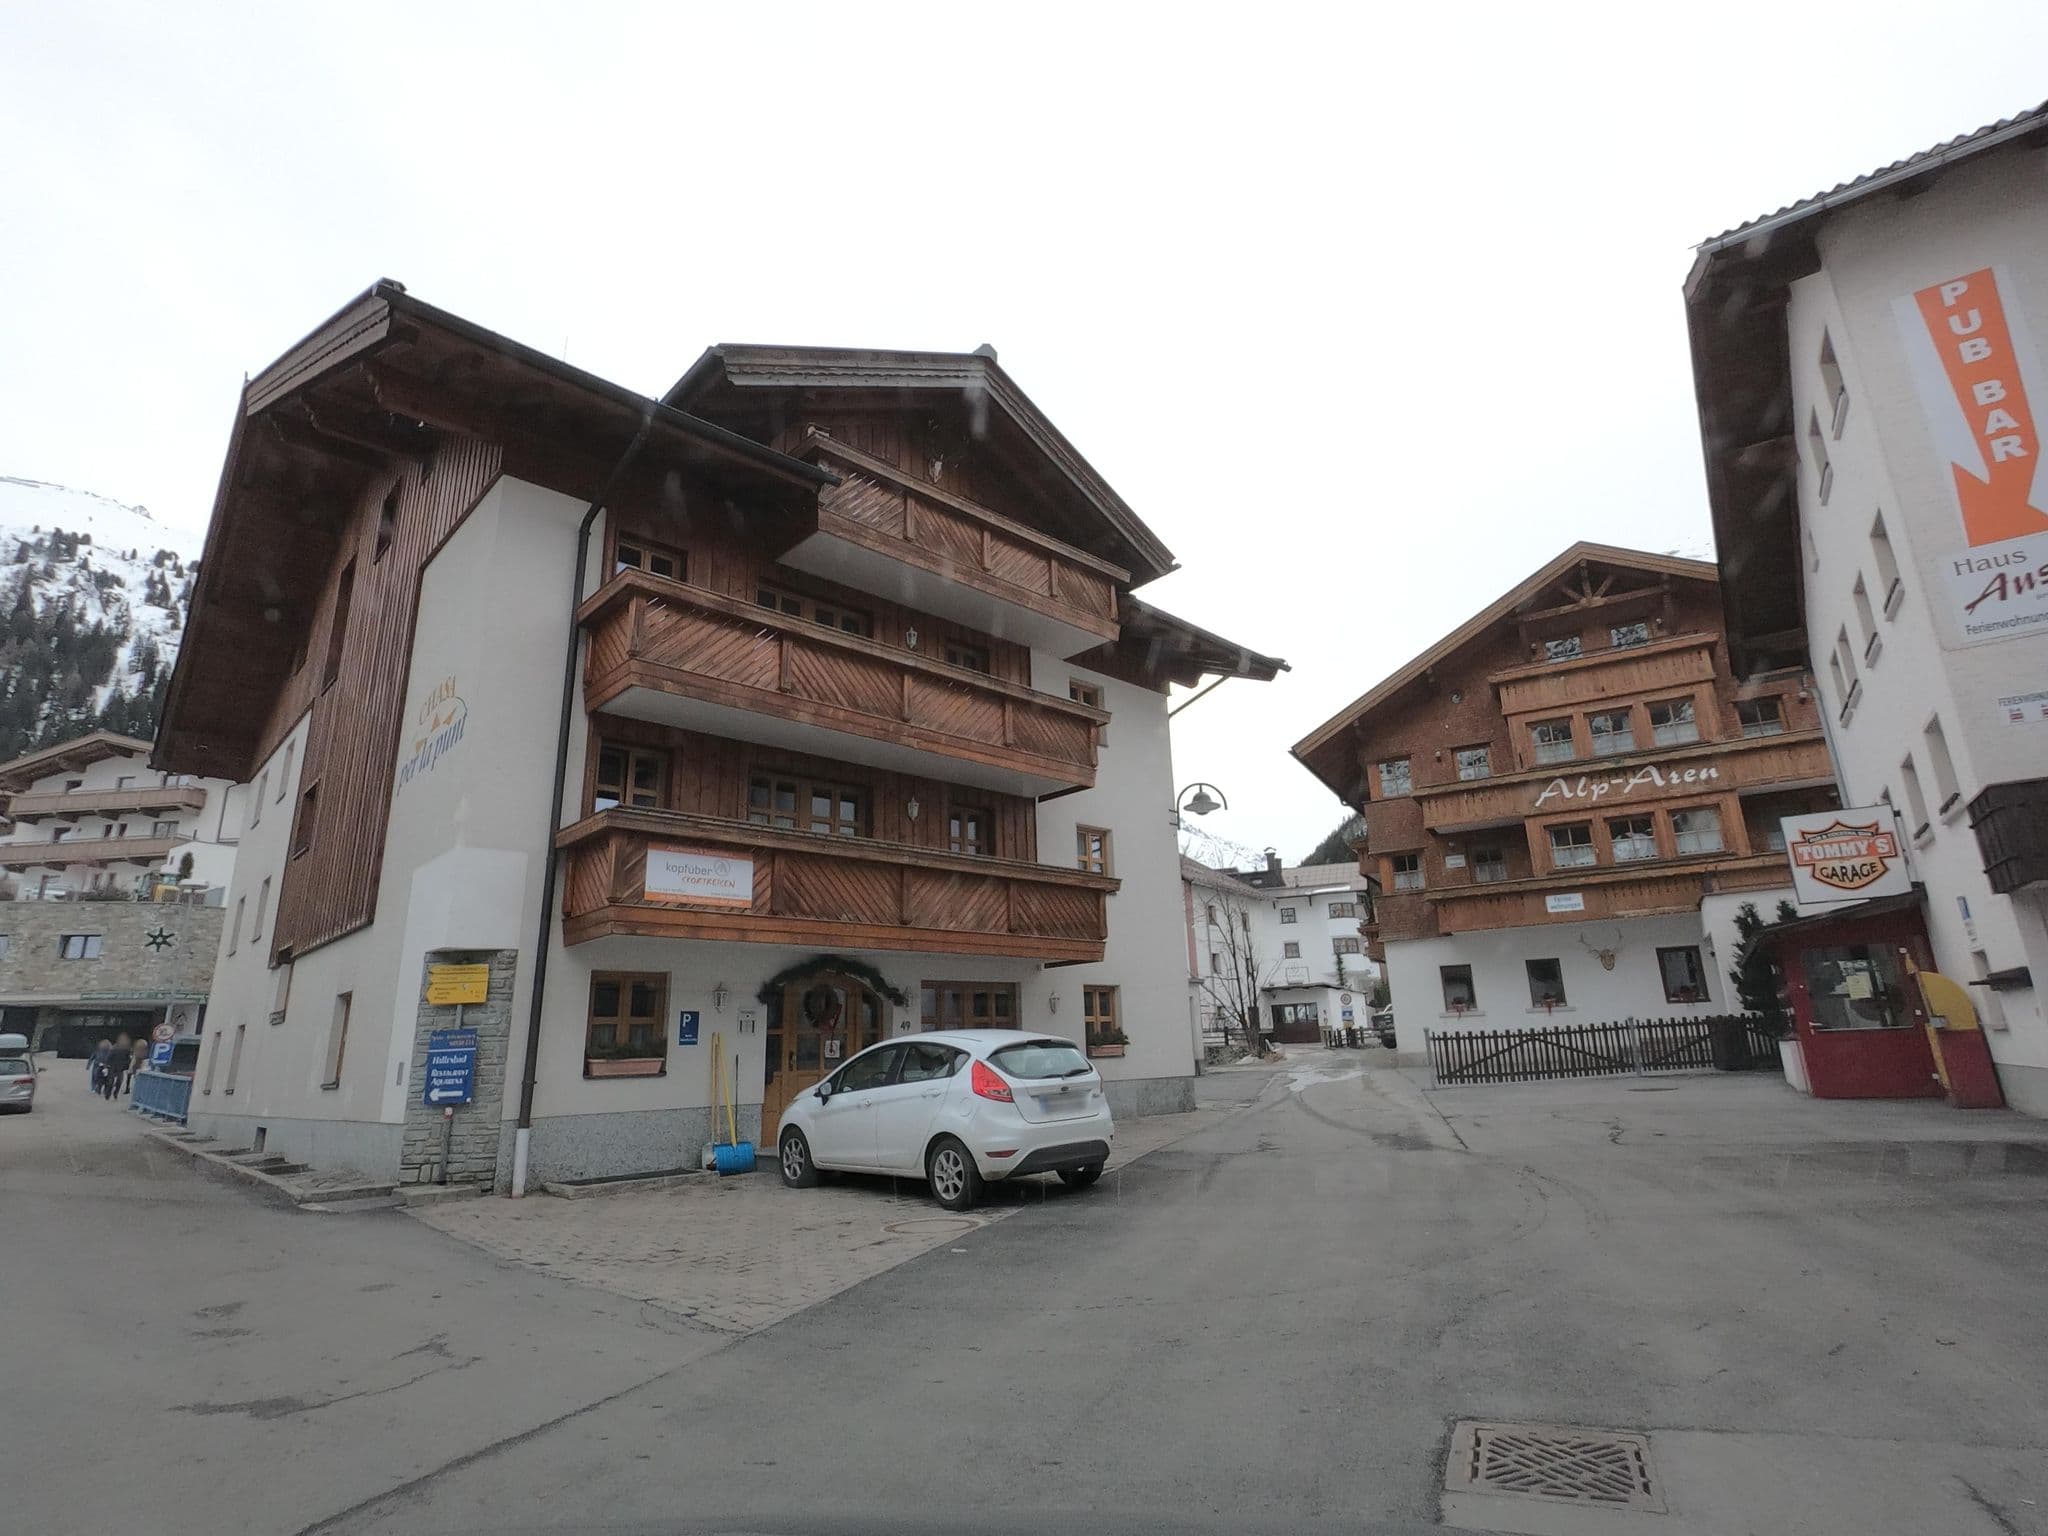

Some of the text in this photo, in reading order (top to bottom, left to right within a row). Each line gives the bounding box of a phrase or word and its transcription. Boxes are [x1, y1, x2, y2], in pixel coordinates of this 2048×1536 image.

[1939, 281, 2029, 463] PUB BAR
[1953, 550, 2028, 576] Haus
[1820, 862, 1879, 882] GARAGE
[683, 1013, 691, 1027] P
[900, 1020, 911, 1031] 49
[154, 1043, 170, 1059] P
